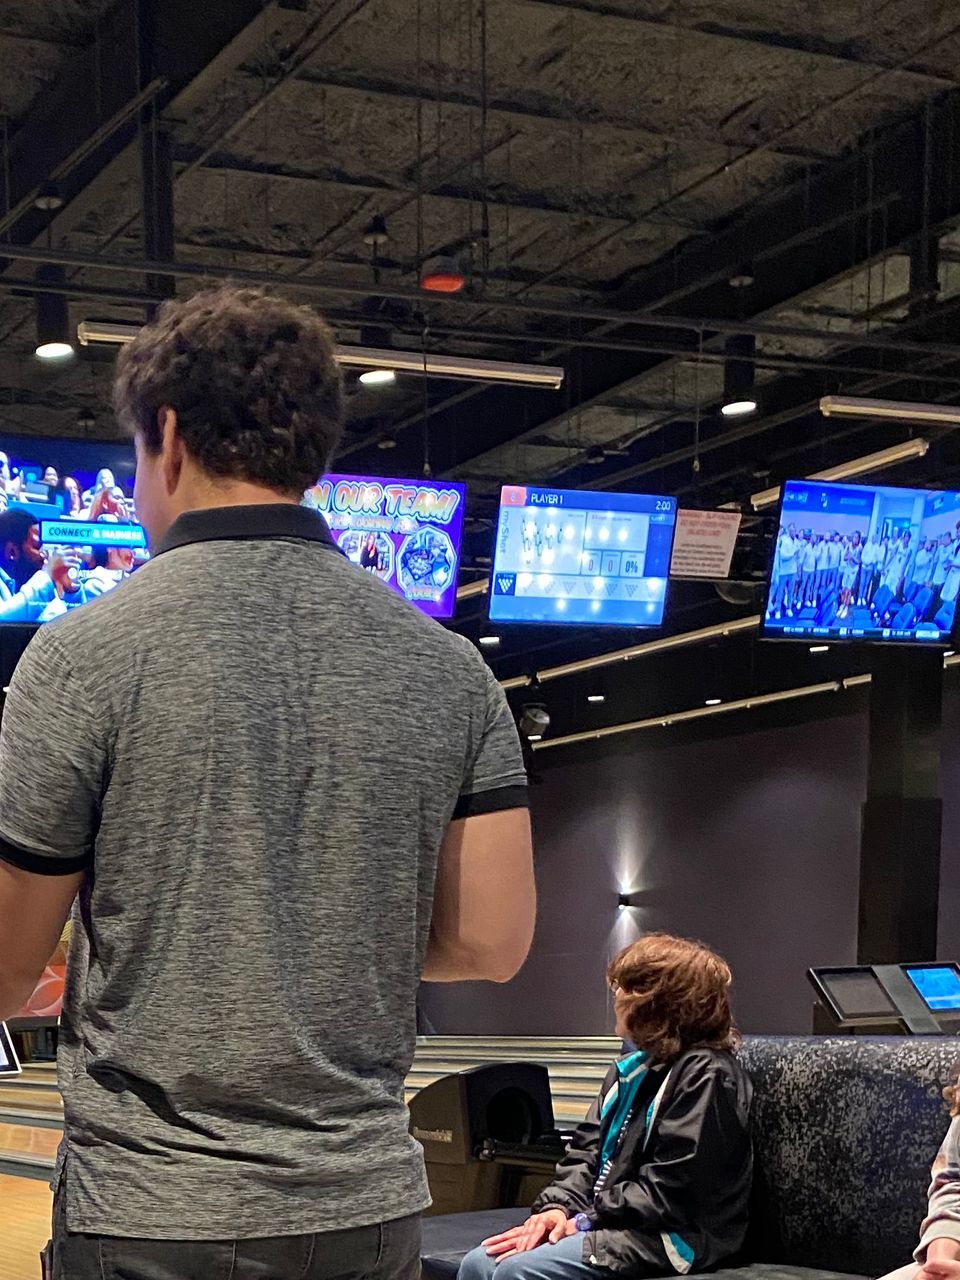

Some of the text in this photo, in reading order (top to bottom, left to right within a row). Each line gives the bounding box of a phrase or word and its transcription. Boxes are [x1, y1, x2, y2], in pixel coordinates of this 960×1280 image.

[339, 486, 381, 513] OUR
[387, 488, 456, 521] TEAM!
[531, 494, 563, 504] PLAYER 1
[656, 501, 671, 510] 2:00
[48, 527, 90, 537] CONNECT
[625, 560, 638, 573] 0%
